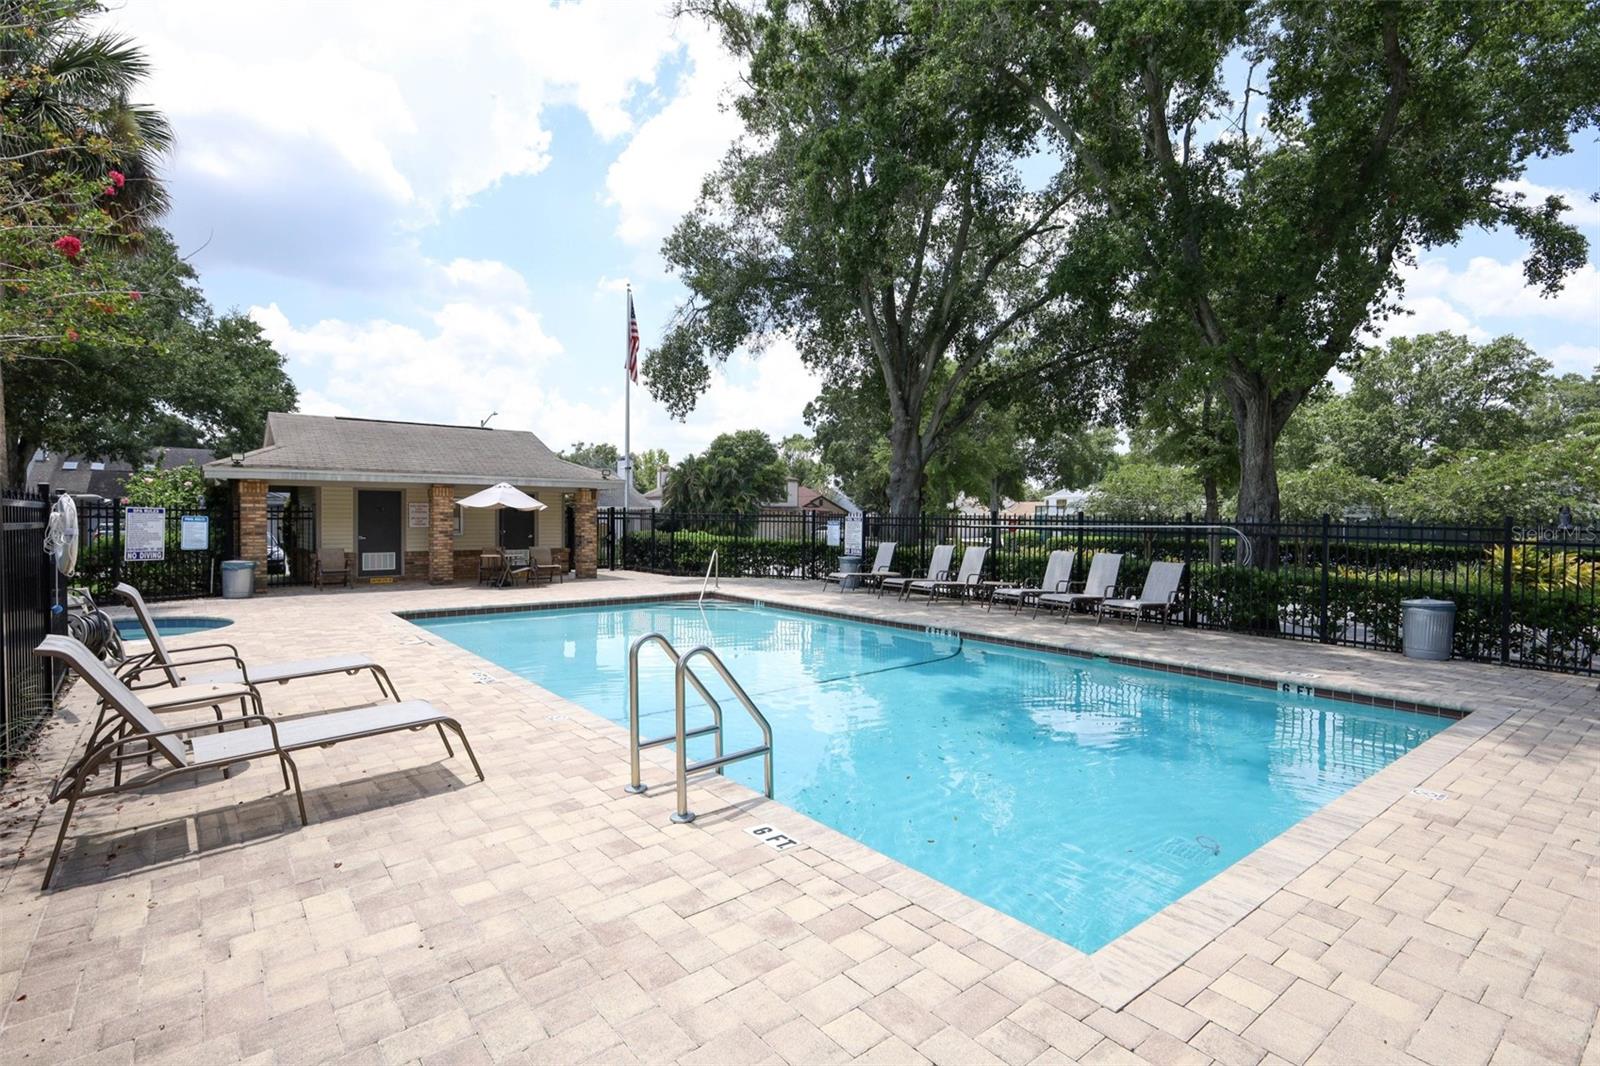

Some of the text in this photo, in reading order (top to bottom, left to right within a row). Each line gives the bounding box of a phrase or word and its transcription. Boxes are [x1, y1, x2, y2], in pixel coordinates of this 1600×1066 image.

[1282, 683, 1312, 696] 6 FT
[753, 827, 773, 835] 6
